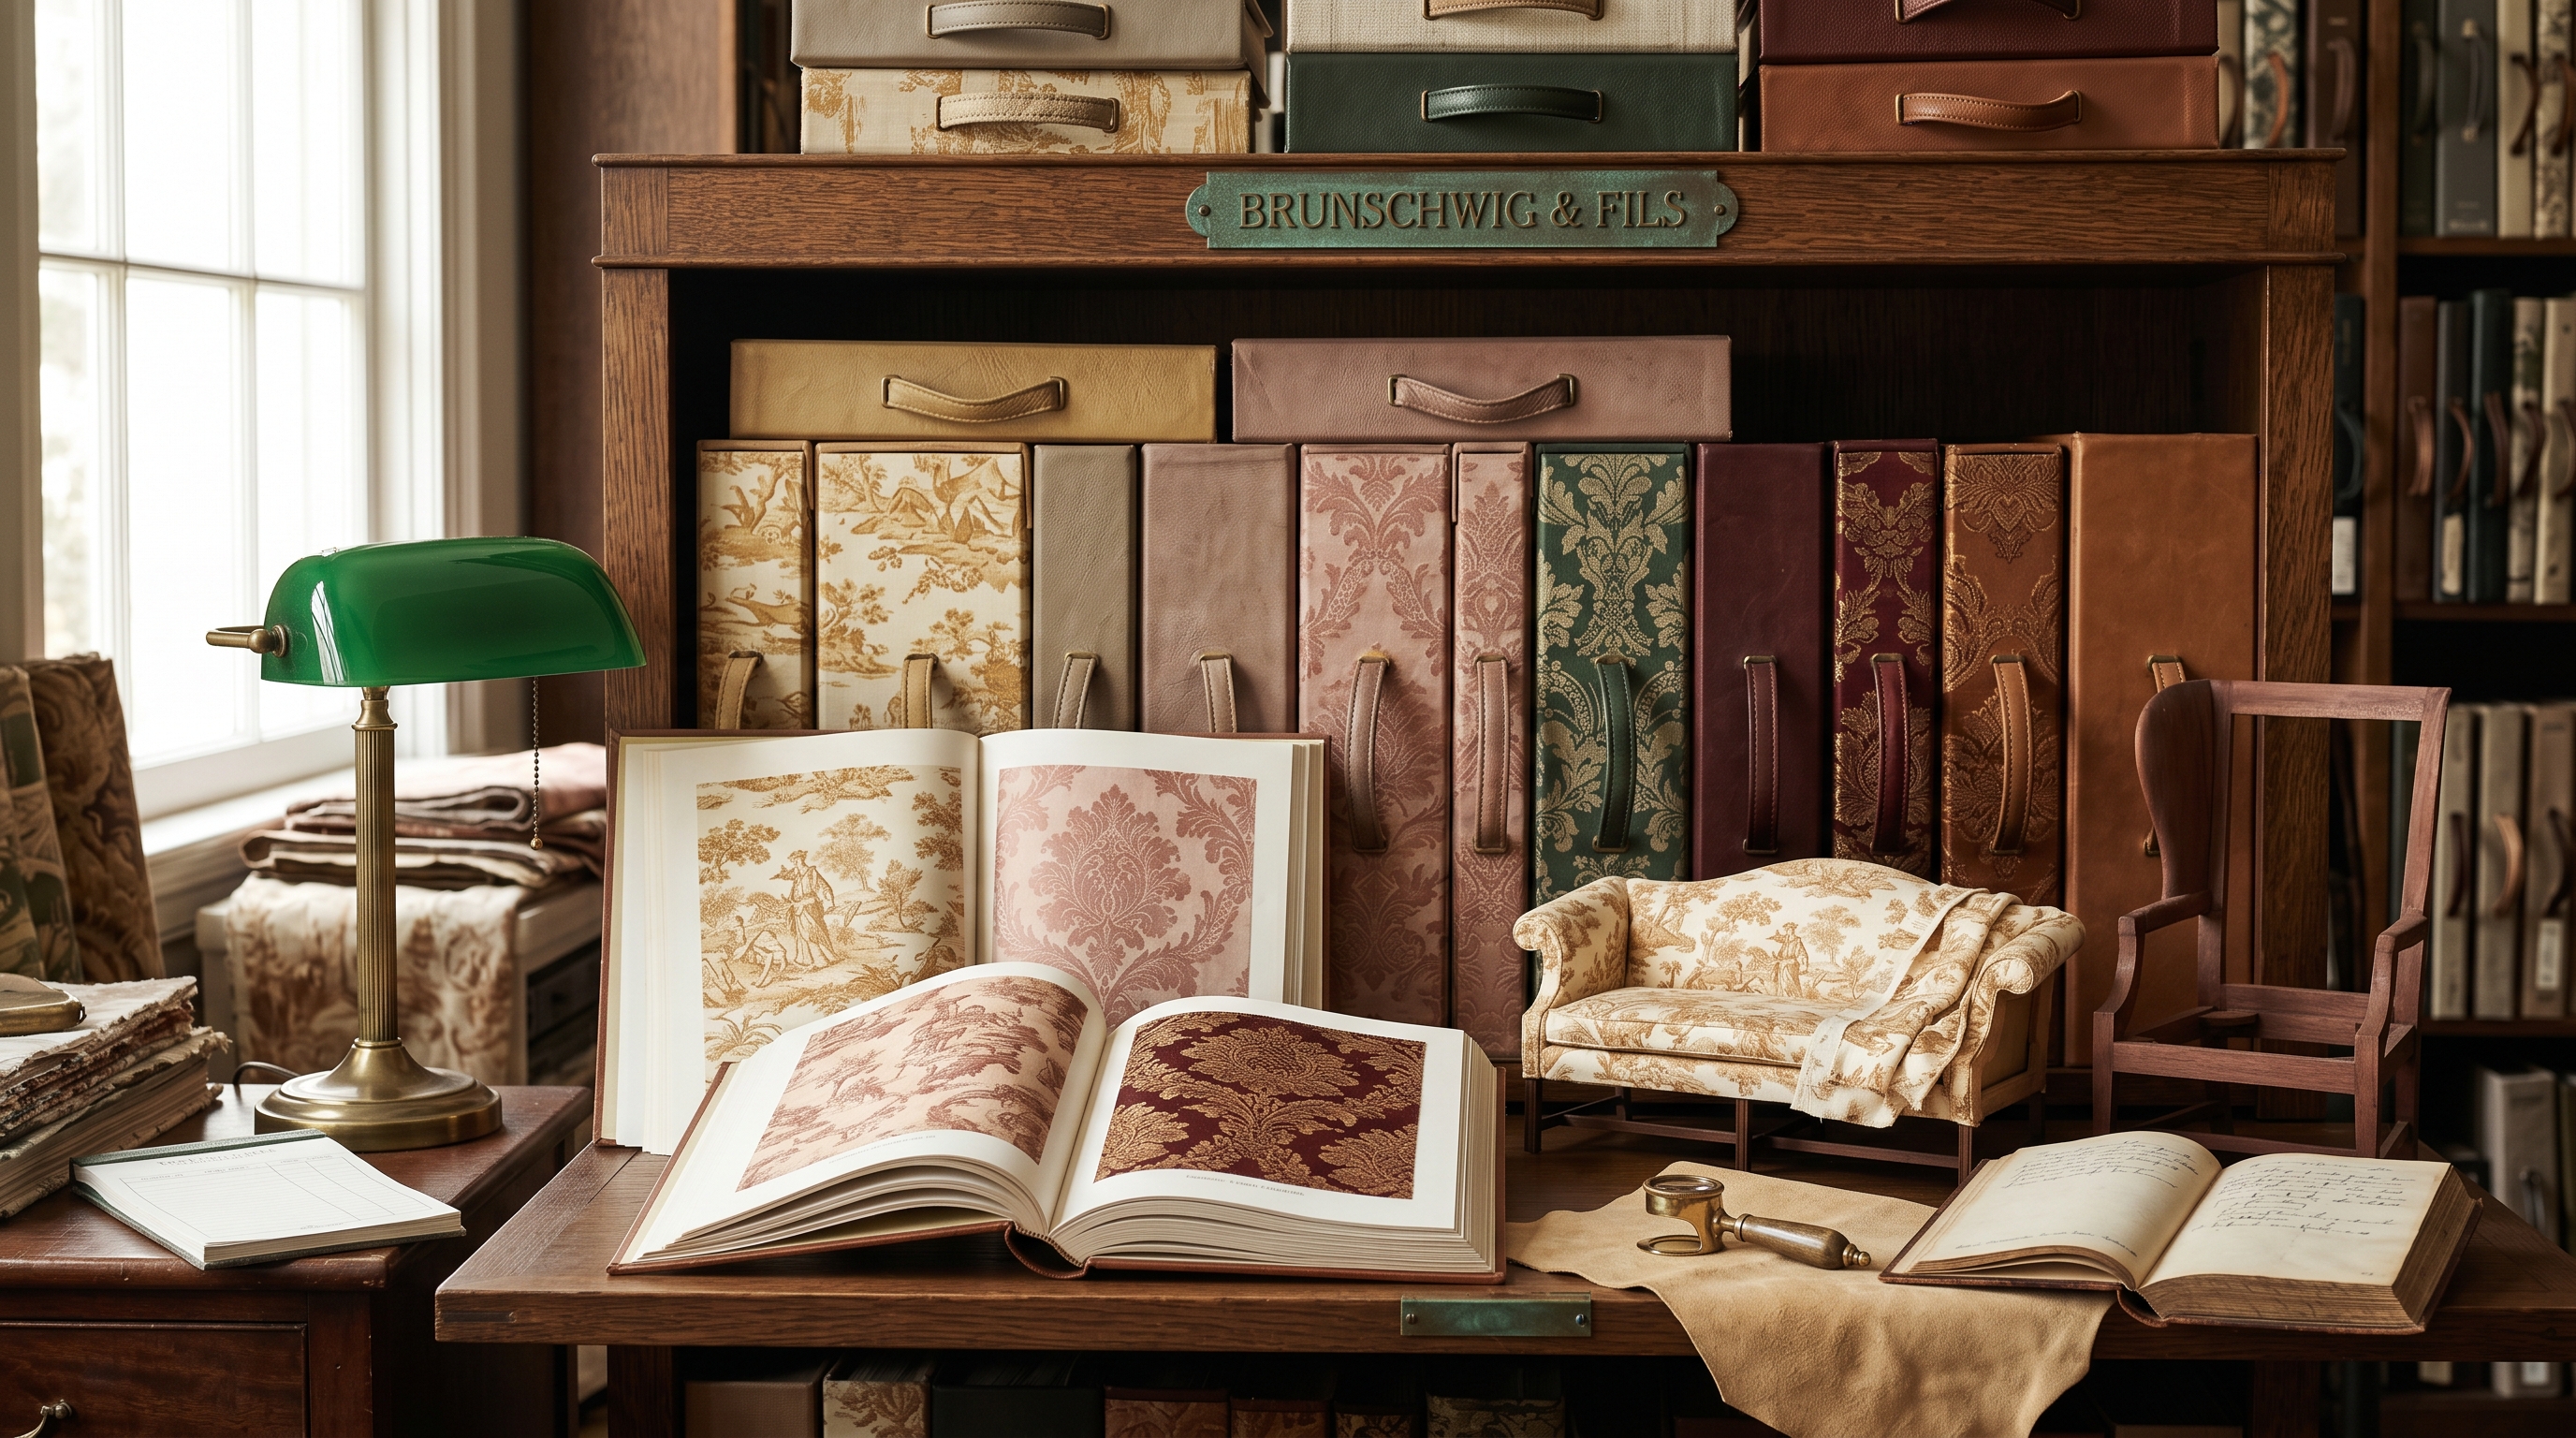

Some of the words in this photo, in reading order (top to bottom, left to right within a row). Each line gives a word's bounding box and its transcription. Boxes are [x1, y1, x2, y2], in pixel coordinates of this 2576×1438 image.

[1238, 191, 1537, 228] BRUNSCHWIG
[1550, 190, 1582, 227] &
[1595, 191, 1686, 228] FILS
